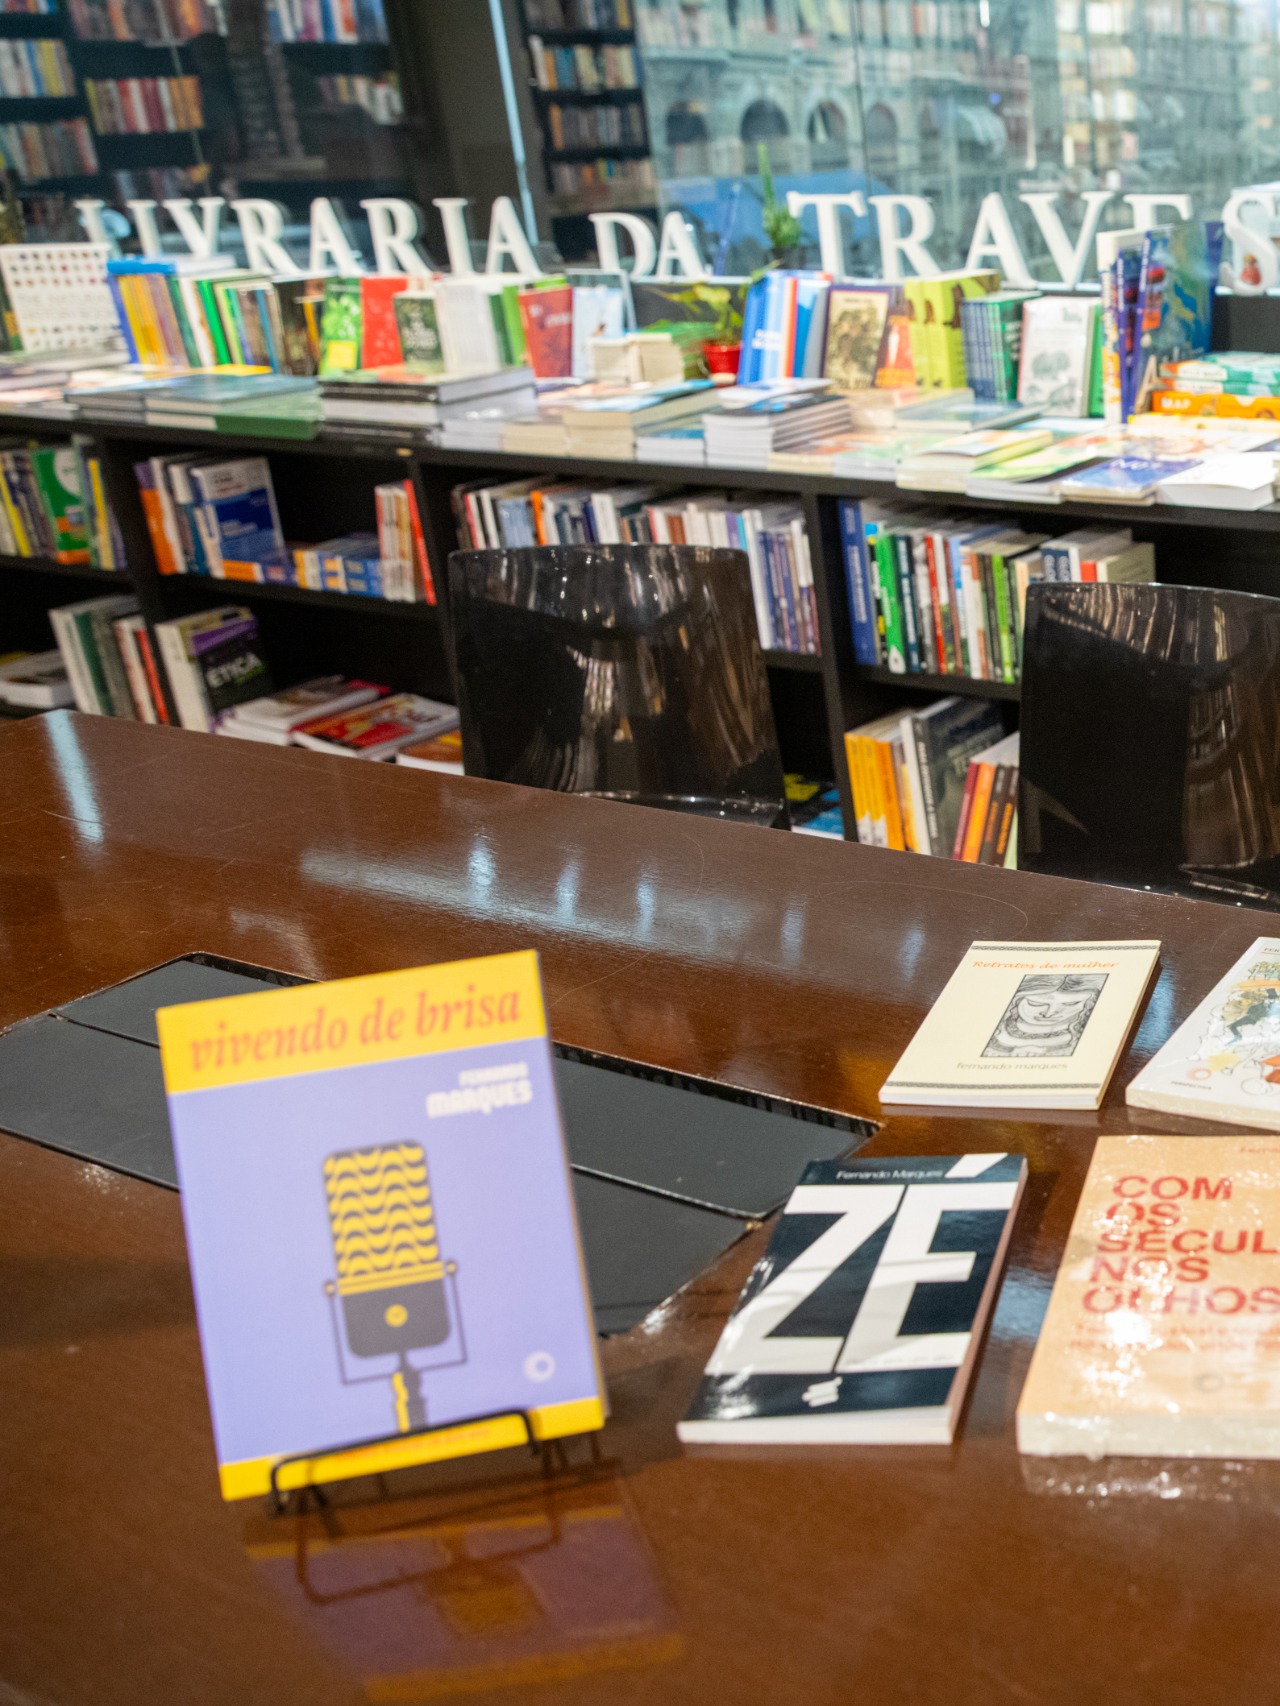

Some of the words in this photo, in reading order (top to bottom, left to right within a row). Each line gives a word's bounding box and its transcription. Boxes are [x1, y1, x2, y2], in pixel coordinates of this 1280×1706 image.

[589, 212, 706, 280] DA
[972, 960, 1035, 970] Retratos
[1039, 960, 1059, 970] de
[1063, 960, 1120, 970] mulher
[190, 1006, 348, 1072] vivendo
[358, 996, 405, 1046] de
[416, 983, 521, 1037] brisa
[955, 1061, 1013, 1071] fernando
[1015, 1062, 1068, 1071] marques
[836, 1169, 890, 1180] Fernando
[893, 1169, 943, 1179] Marques
[1112, 1175, 1233, 1201] COM
[1105, 1201, 1182, 1227] OS
[704, 1153, 1008, 1376] ZÉ
[1088, 1256, 1211, 1283] NOS
